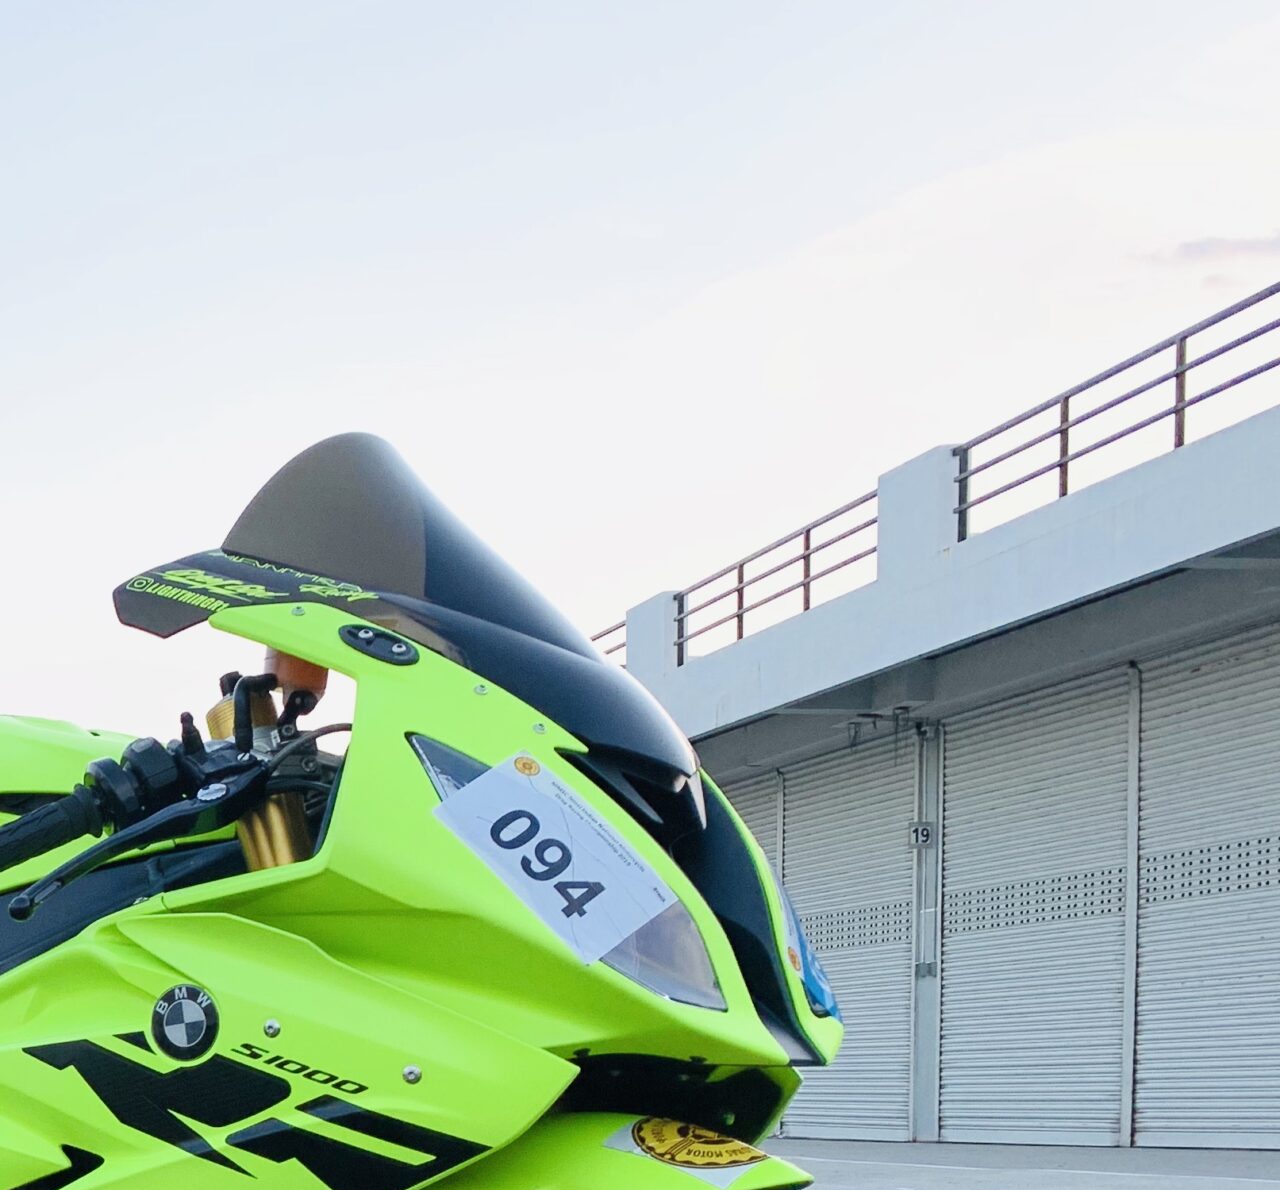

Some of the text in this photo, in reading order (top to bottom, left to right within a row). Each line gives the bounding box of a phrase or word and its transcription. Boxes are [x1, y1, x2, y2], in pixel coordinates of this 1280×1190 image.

[912, 828, 930, 843] 19
[490, 809, 606, 918] 094
[156, 986, 211, 1015] BMW
[230, 1043, 369, 1094] S1000
[686, 1147, 723, 1159] MOTOR
